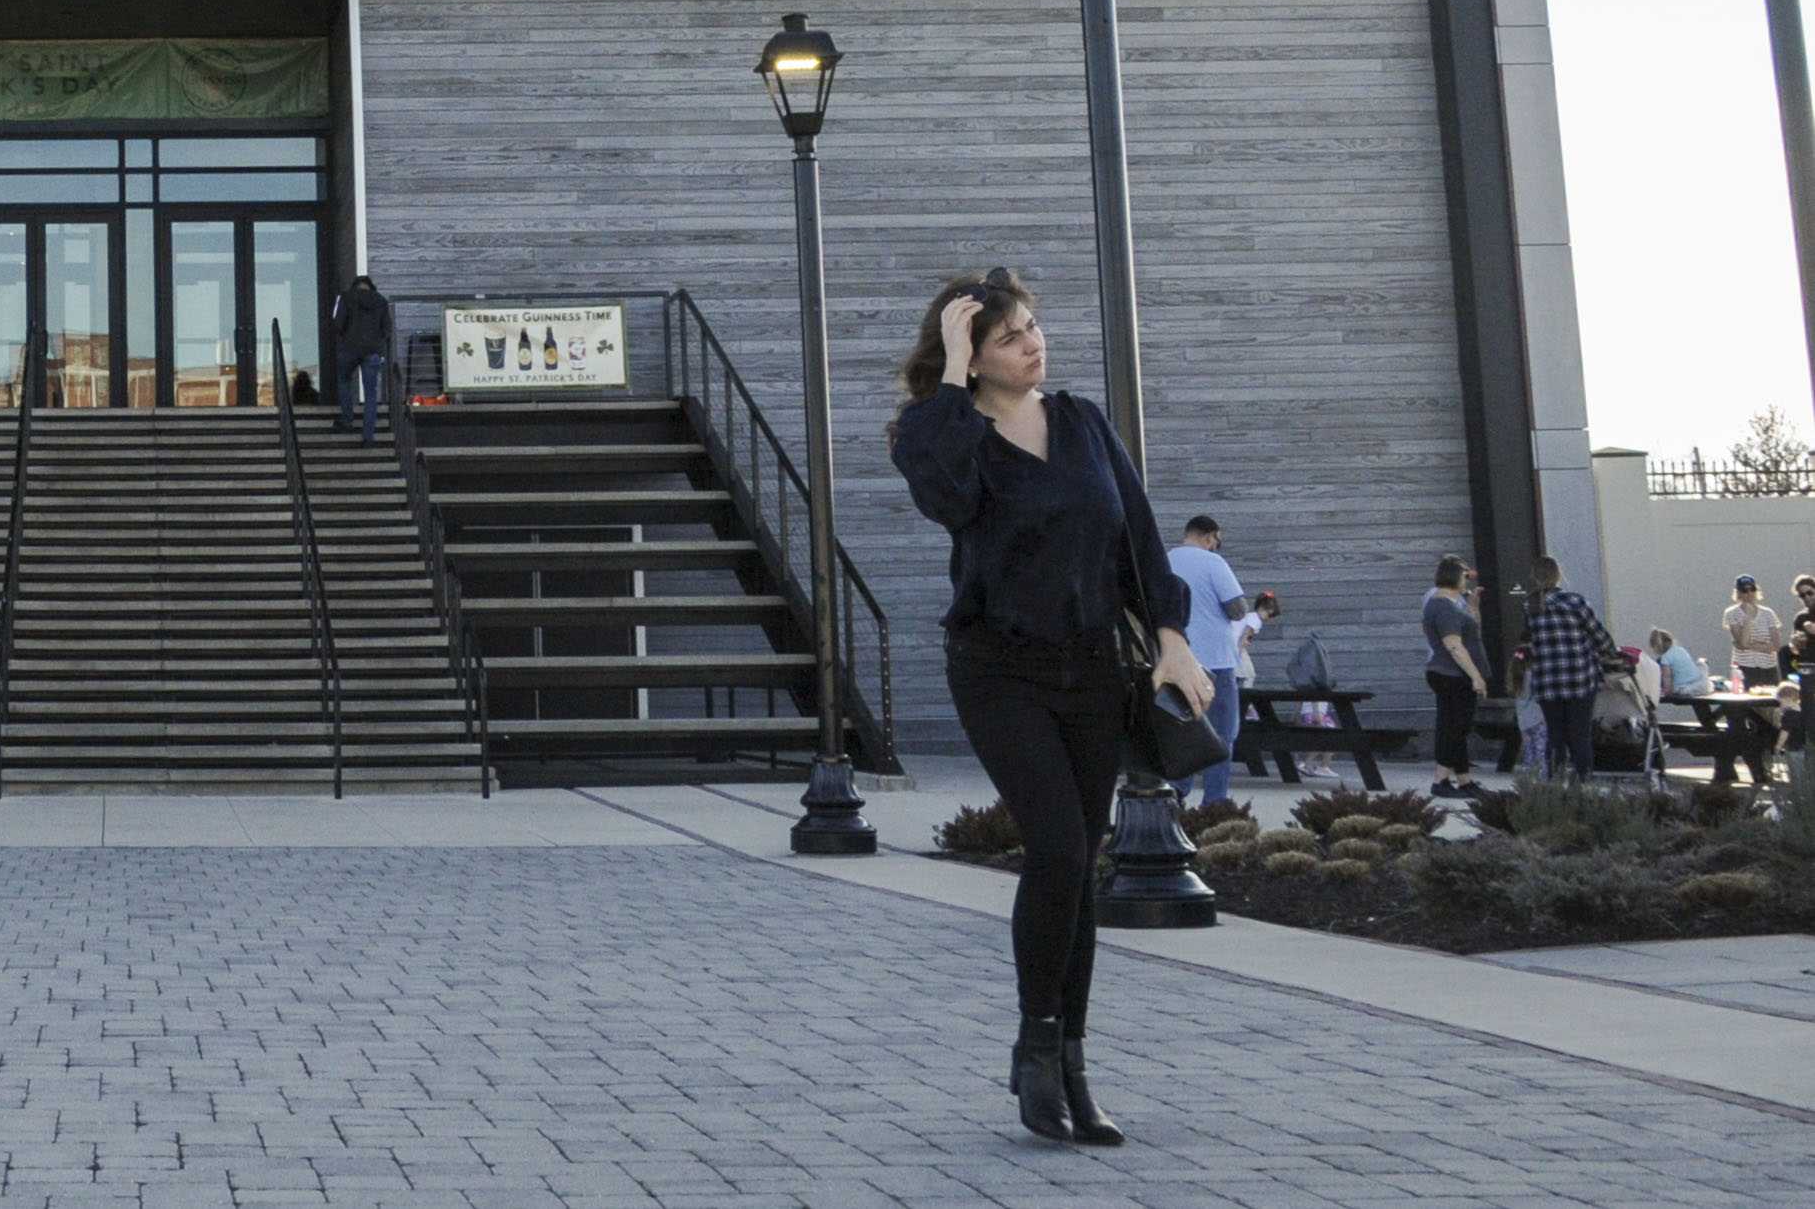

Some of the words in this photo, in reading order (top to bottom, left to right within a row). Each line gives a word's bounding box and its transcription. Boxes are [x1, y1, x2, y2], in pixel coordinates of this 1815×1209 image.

[18, 52, 108, 74] SAINT
[62, 74, 120, 95] DAY
[454, 313, 519, 324] CELEBRATE
[522, 312, 581, 323] GUINNESS
[586, 311, 612, 321] TIME
[473, 375, 504, 384] HAPPY
[509, 375, 521, 383] ST.
[526, 374, 574, 382] PATRICK'S
